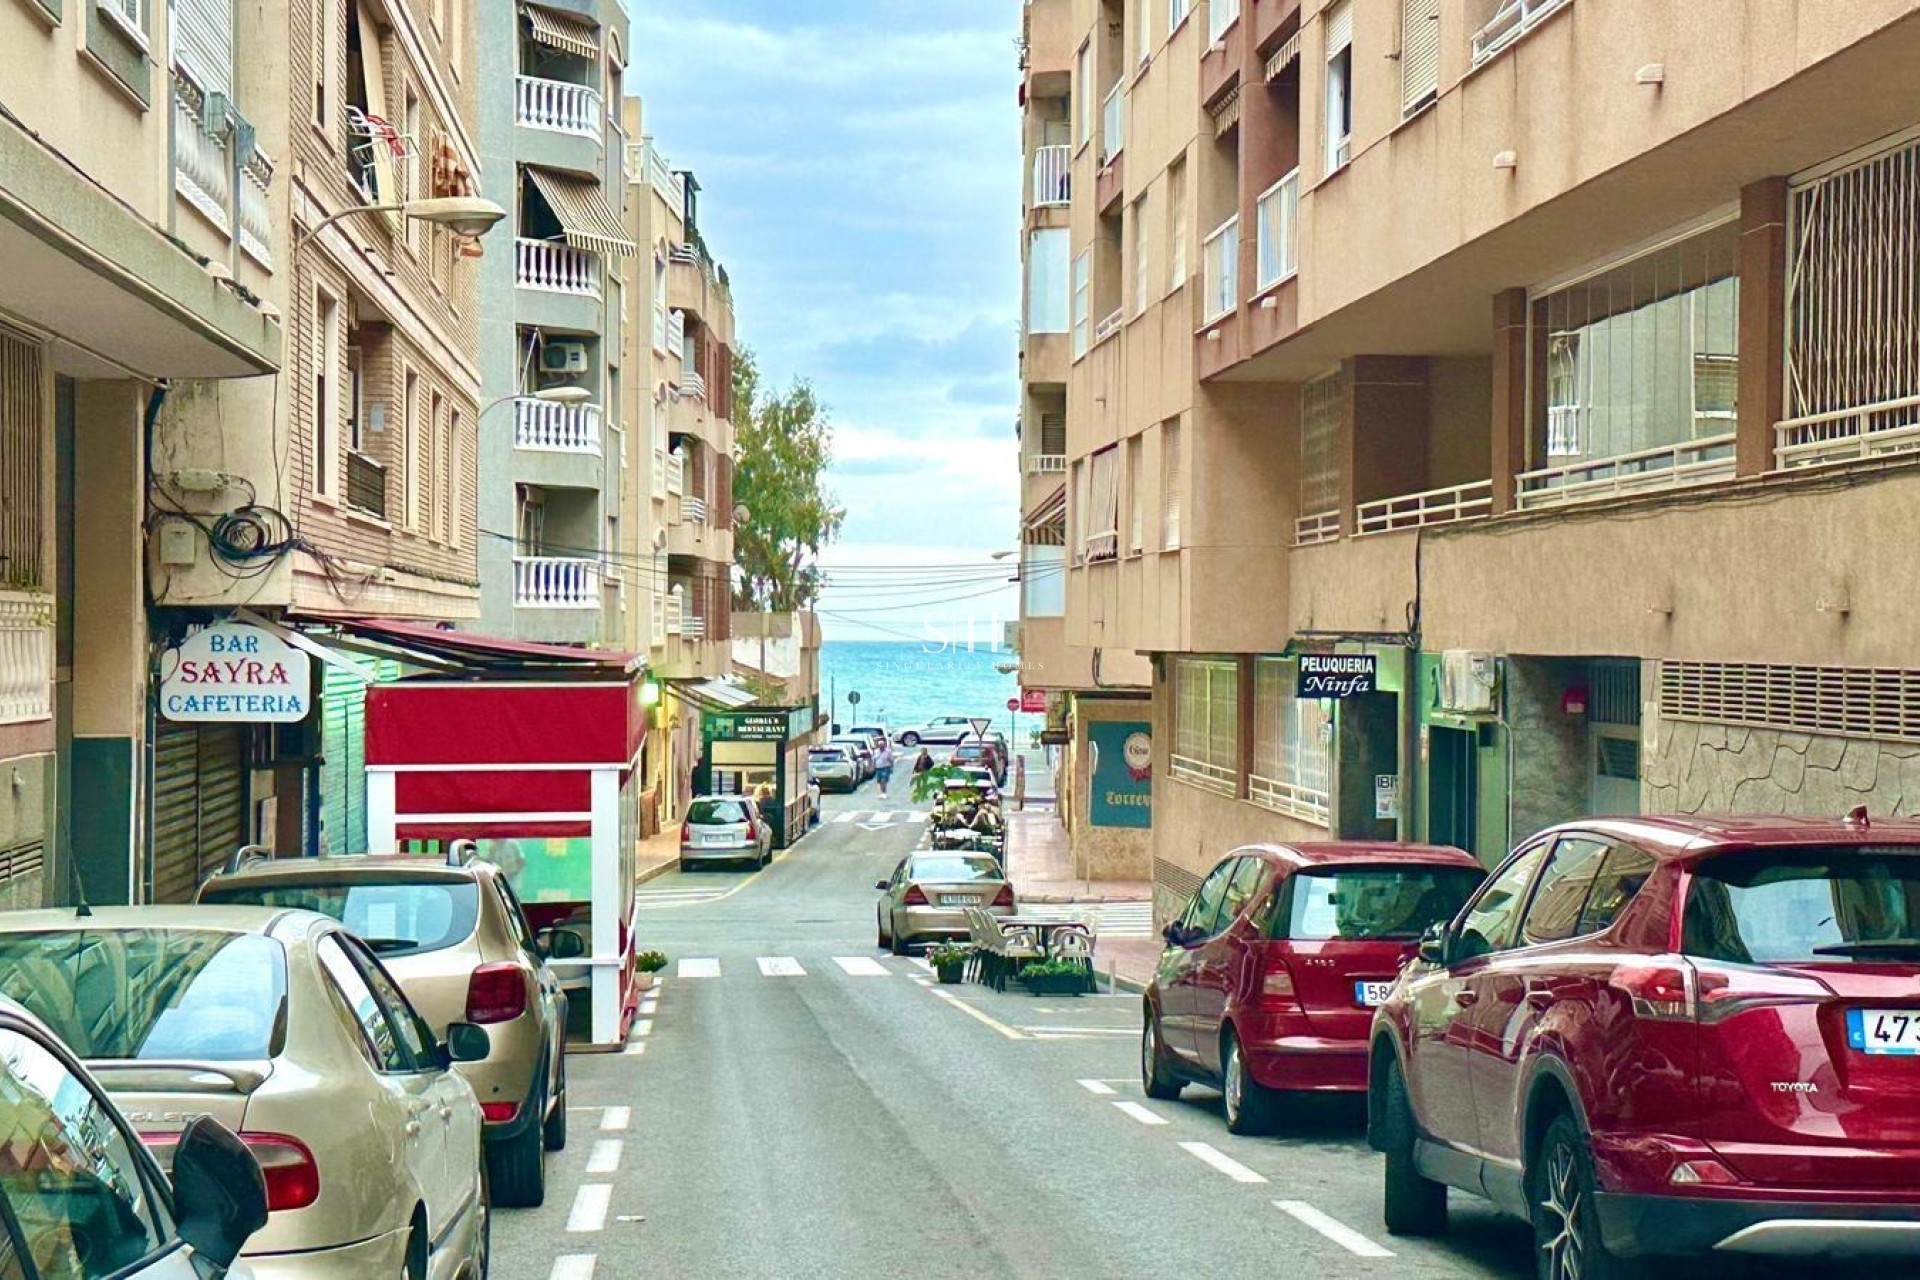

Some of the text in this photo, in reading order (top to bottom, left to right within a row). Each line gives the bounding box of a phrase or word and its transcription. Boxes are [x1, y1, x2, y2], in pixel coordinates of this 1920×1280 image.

[210, 633, 258, 653] BAR
[179, 657, 290, 685] SAYRA
[1300, 656, 1374, 673] PELUQUERIA
[1303, 675, 1369, 697] Ninfa
[167, 694, 302, 713] CAFETERIA
[1366, 984, 1393, 1001] 58
[1770, 1081, 1819, 1093] TOYOTA
